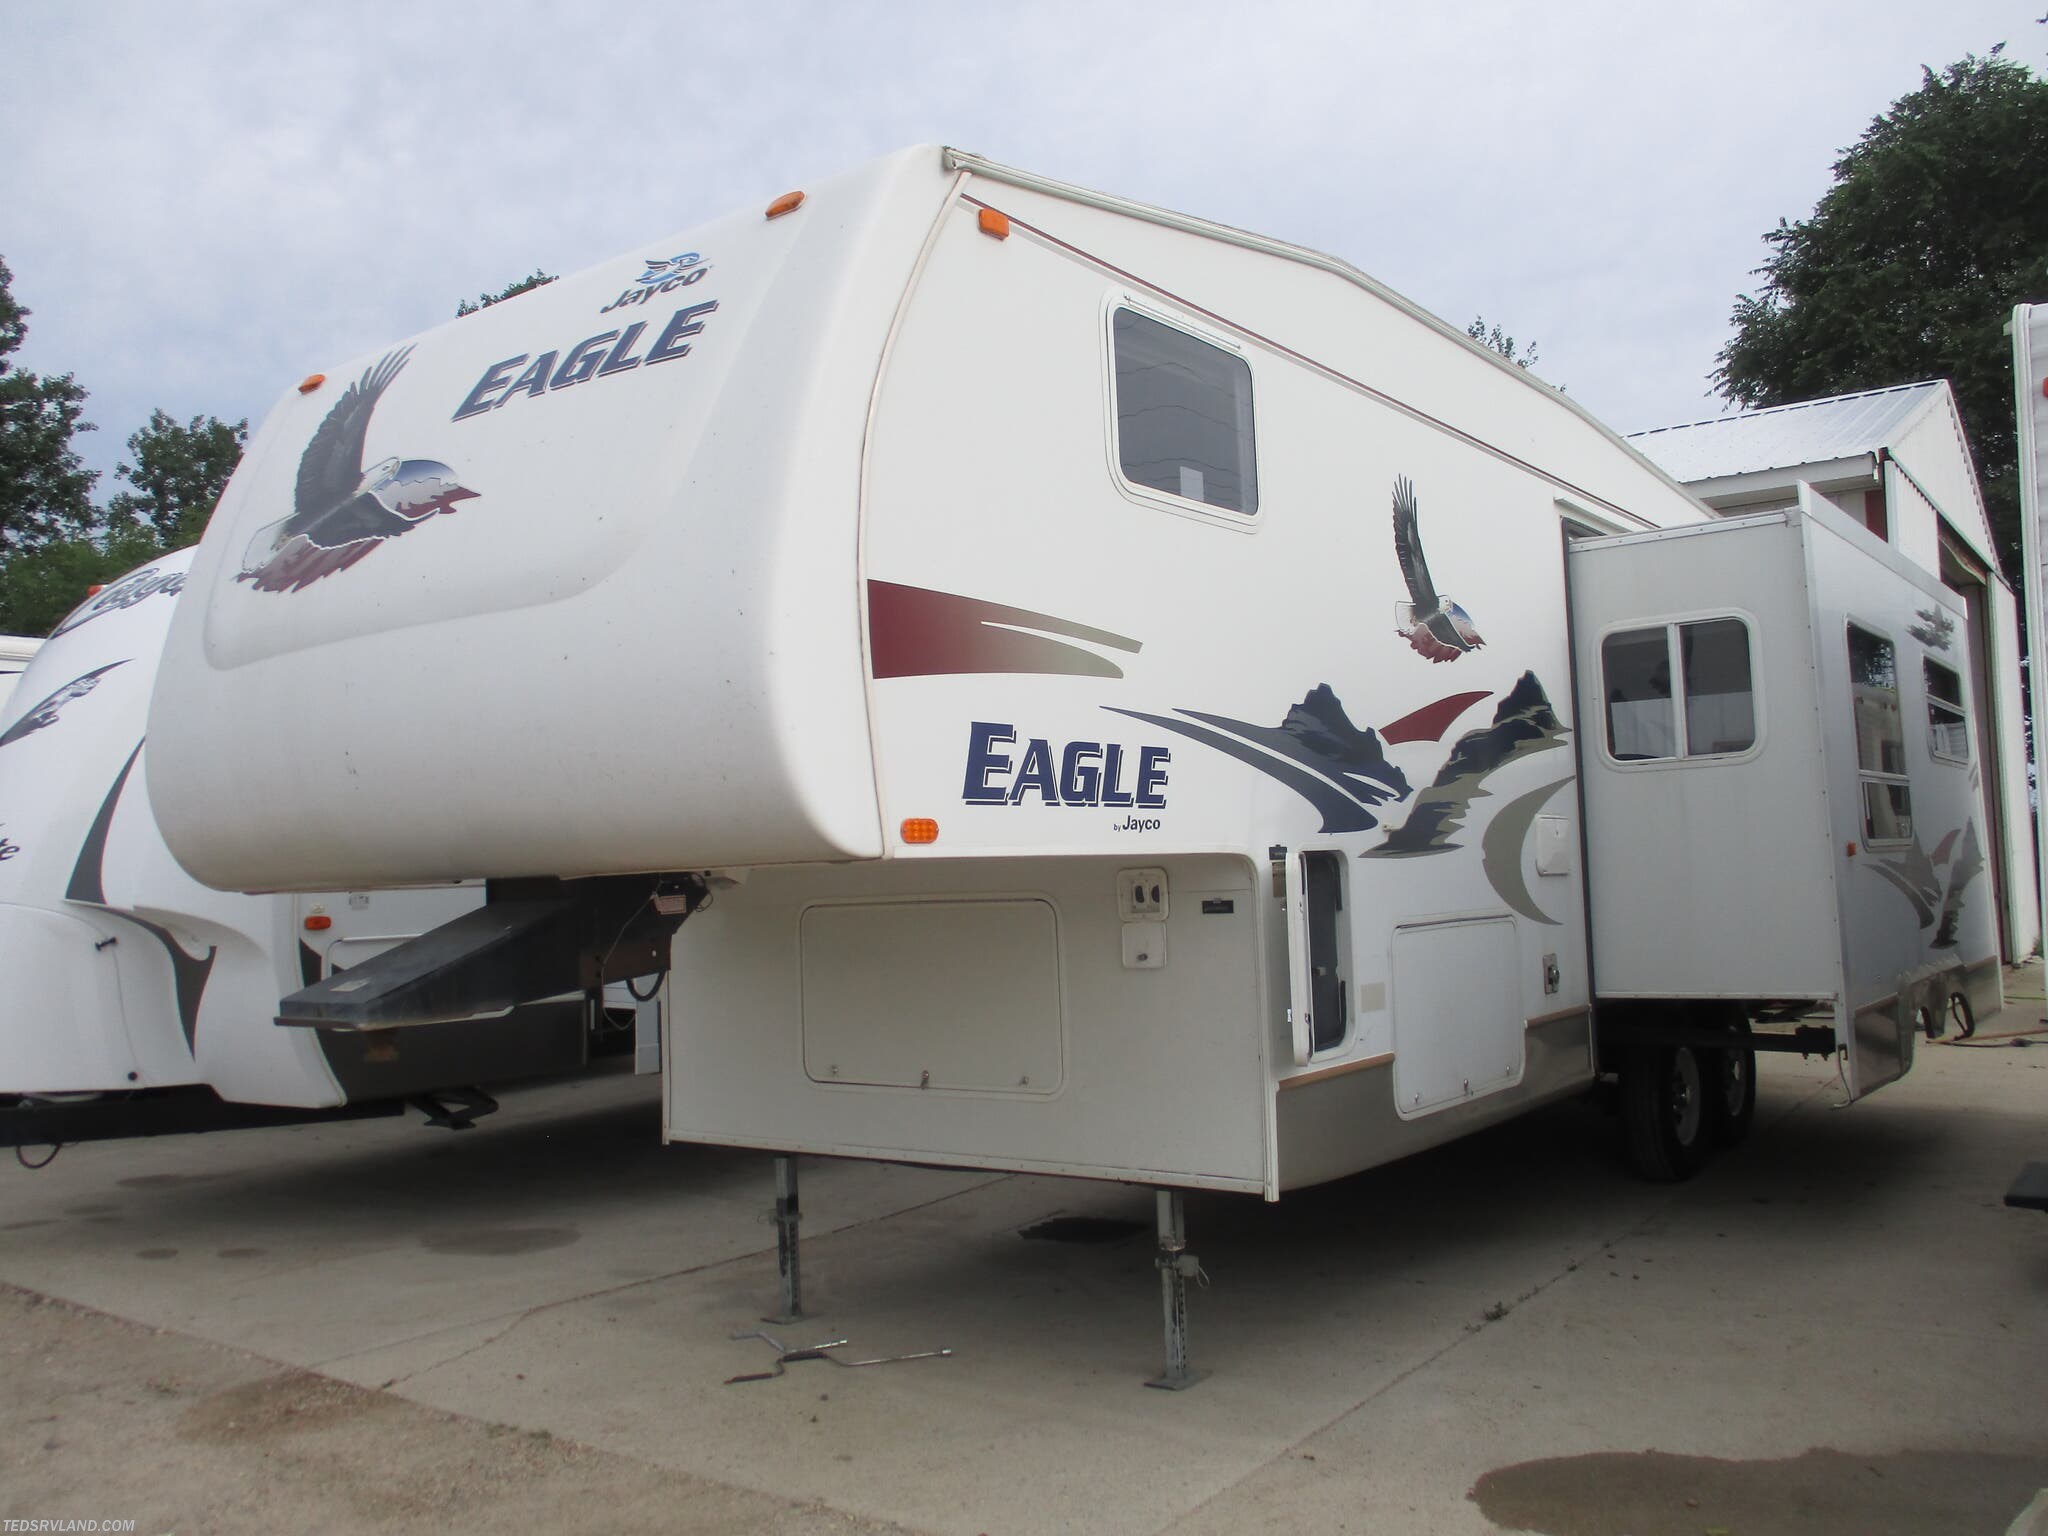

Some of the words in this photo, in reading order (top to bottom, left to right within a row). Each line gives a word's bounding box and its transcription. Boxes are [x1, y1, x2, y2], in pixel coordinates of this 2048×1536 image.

[600, 267, 708, 314] Jayco
[451, 299, 719, 423] EAGLE
[962, 721, 1171, 809] EAGLE
[1113, 823, 1122, 832] by
[1122, 815, 1161, 833] Jayco
